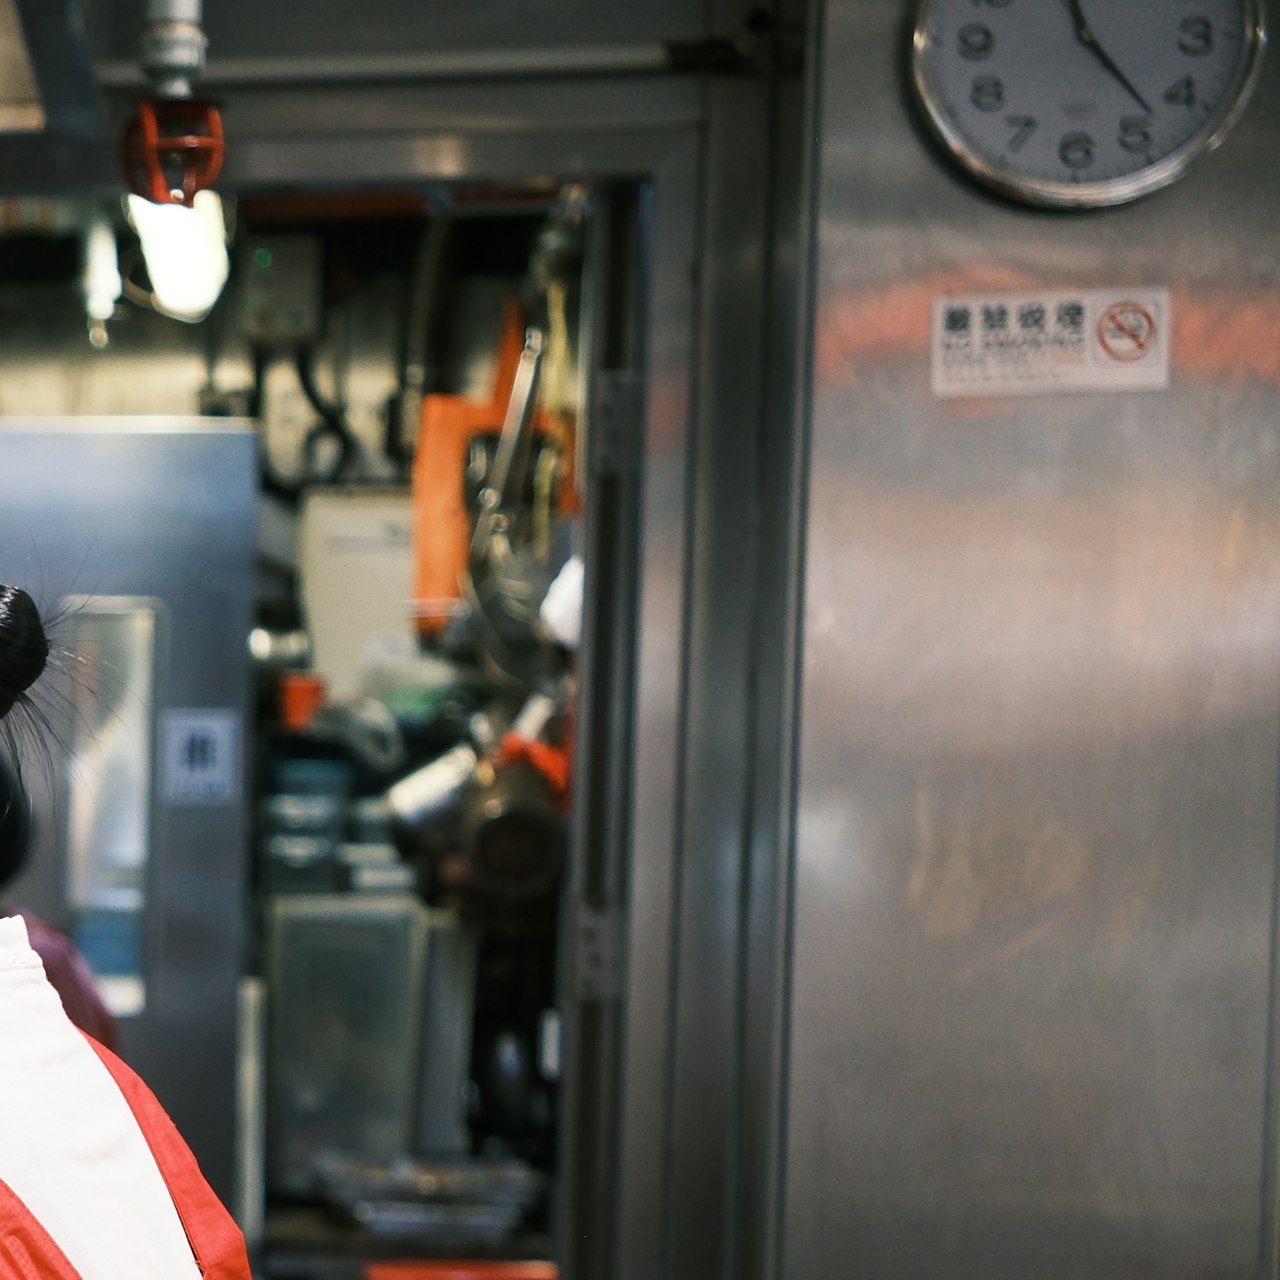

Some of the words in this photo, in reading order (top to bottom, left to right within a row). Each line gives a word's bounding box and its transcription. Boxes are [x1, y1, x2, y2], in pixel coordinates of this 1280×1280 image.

[957, 23, 994, 60] 9
[1177, 14, 1213, 56] 3
[969, 74, 1005, 113] 8
[1164, 75, 1195, 106] 4
[1005, 115, 1038, 148] 7
[1057, 131, 1096, 168] 6
[1117, 114, 1152, 153] 5
